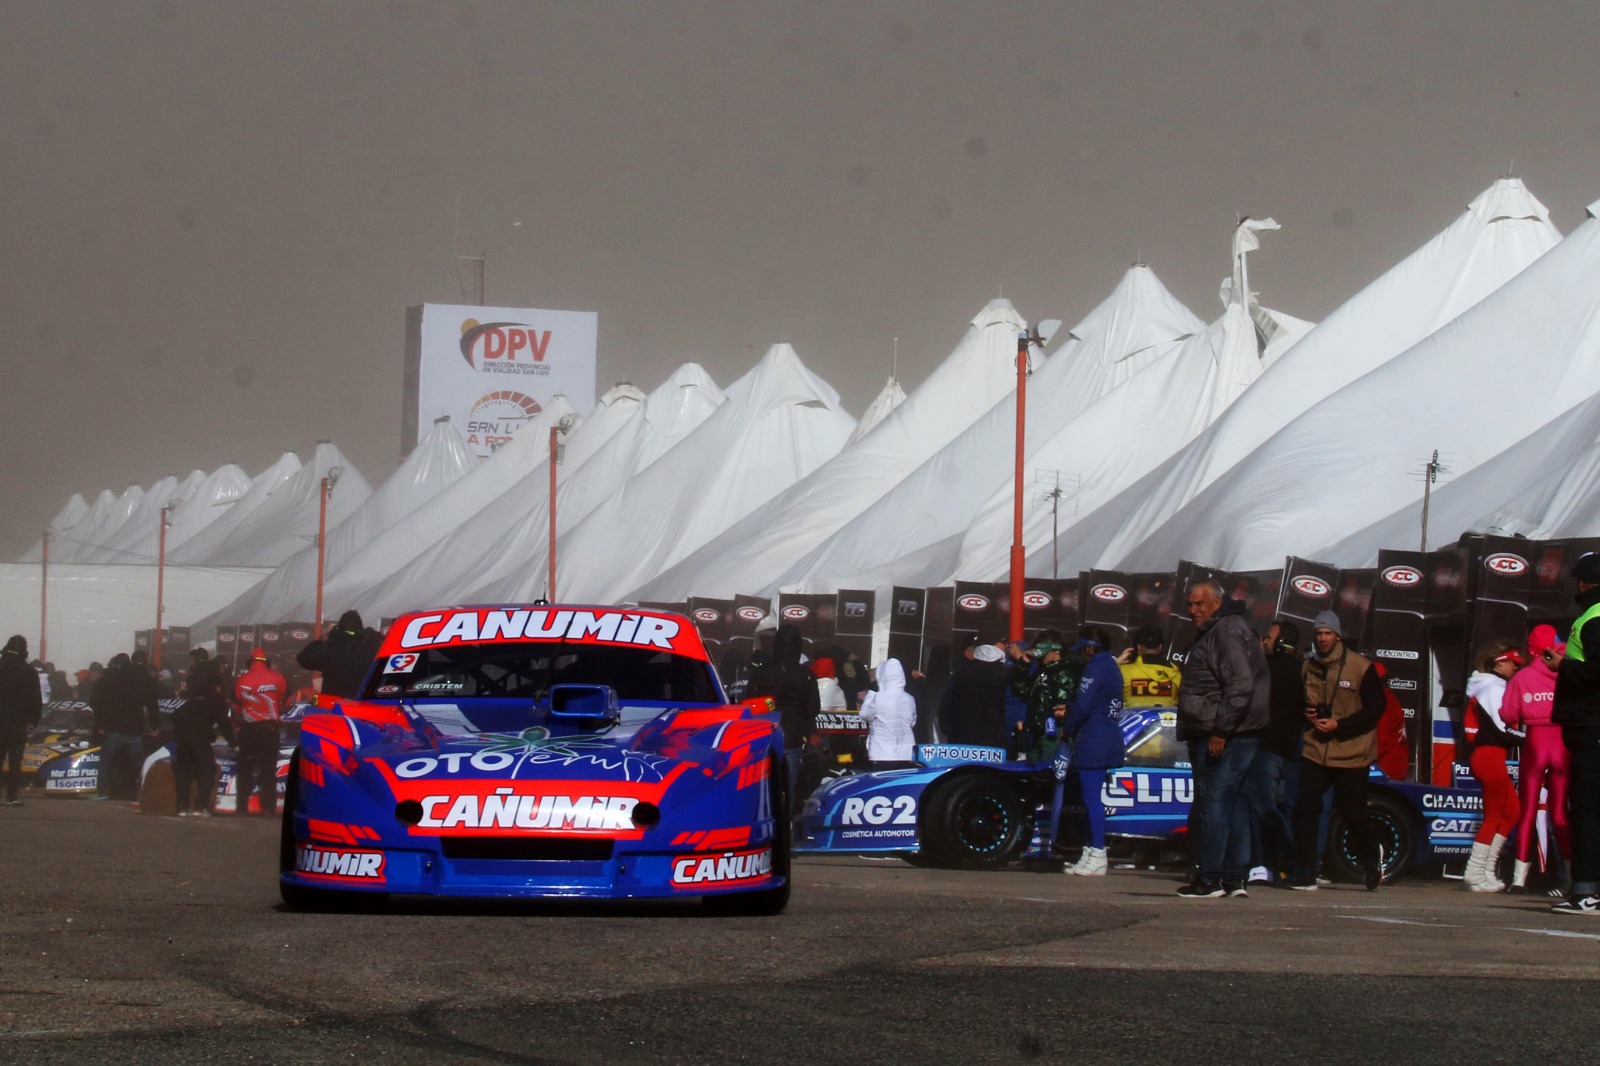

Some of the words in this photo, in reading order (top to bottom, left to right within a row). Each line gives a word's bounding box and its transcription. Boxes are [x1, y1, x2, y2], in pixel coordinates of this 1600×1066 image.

[484, 328, 552, 362] DPV
[516, 363, 551, 371] PROVINCIAL
[467, 421, 499, 434] SAN
[467, 434, 479, 445] A
[938, 747, 1003, 762] HOUSFIN
[842, 795, 916, 825] RG2
[842, 829, 873, 838] COSMÉTICA
[873, 829, 915, 838] AUTOMOTOR
